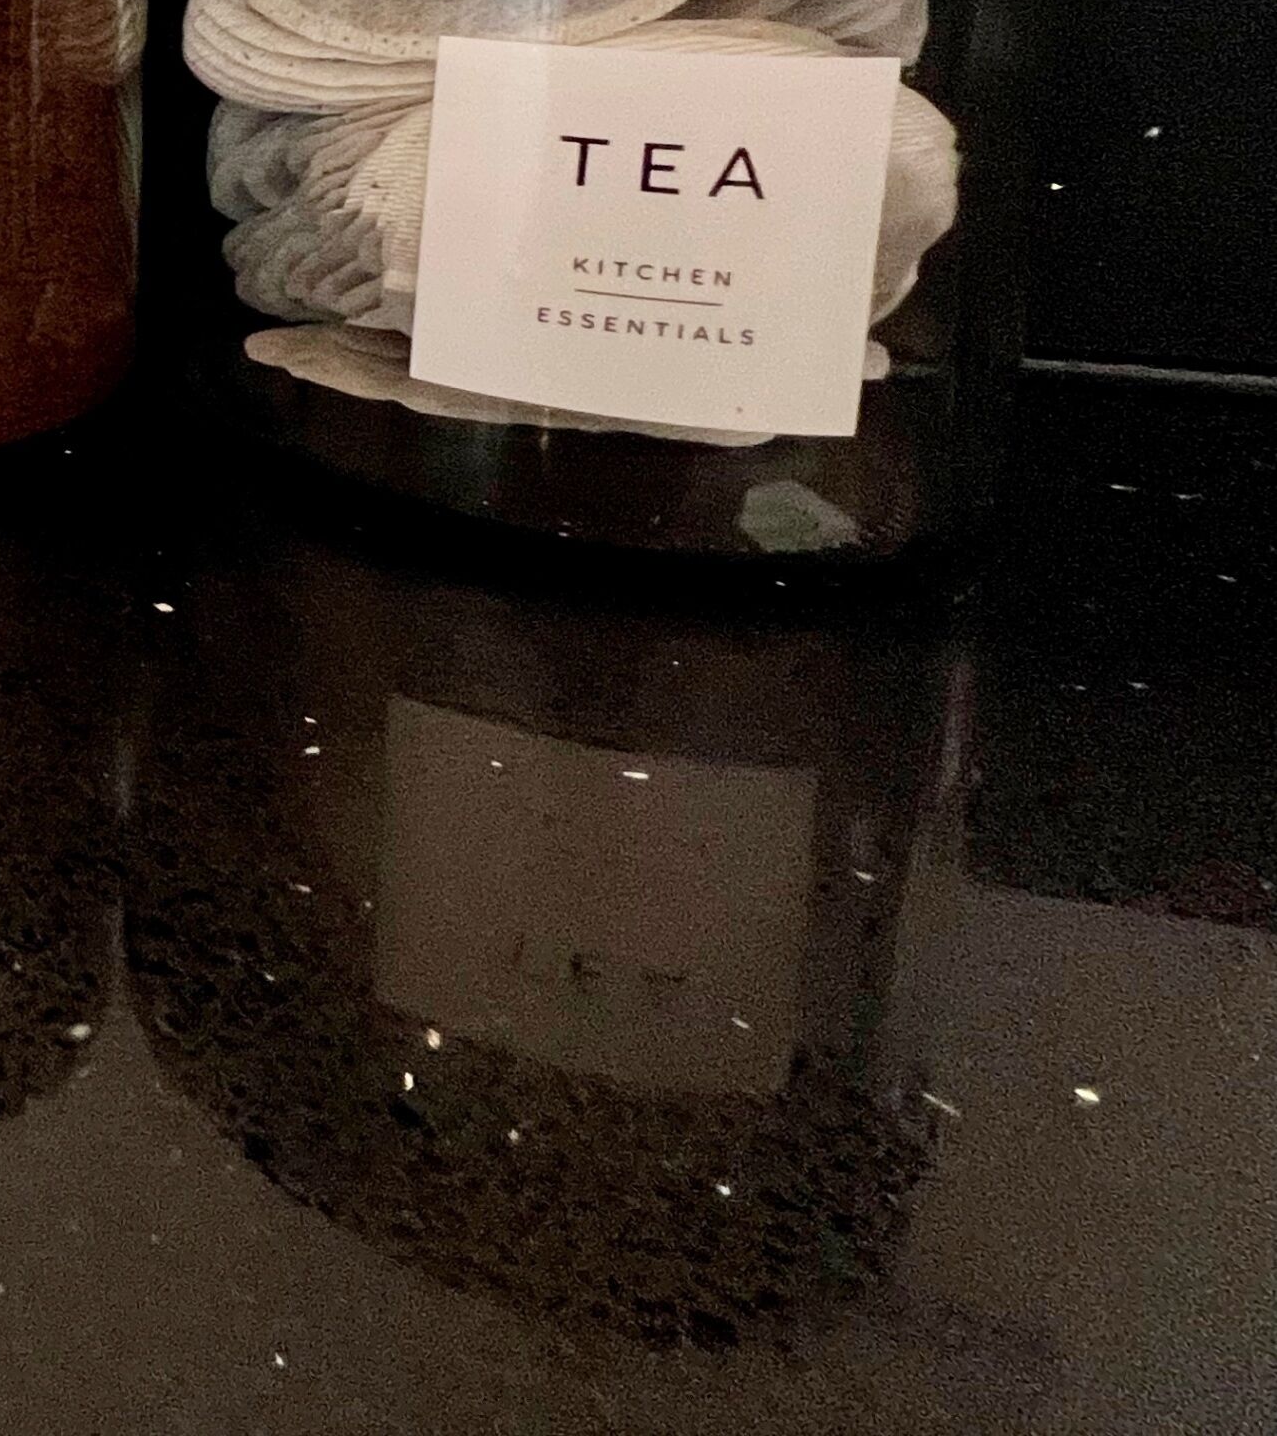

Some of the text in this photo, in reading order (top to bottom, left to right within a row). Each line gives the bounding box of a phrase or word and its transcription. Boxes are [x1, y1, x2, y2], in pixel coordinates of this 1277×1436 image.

[559, 134, 766, 201] TEA
[572, 256, 734, 288] KITCHEN
[536, 306, 756, 347] ESSENTIALS
